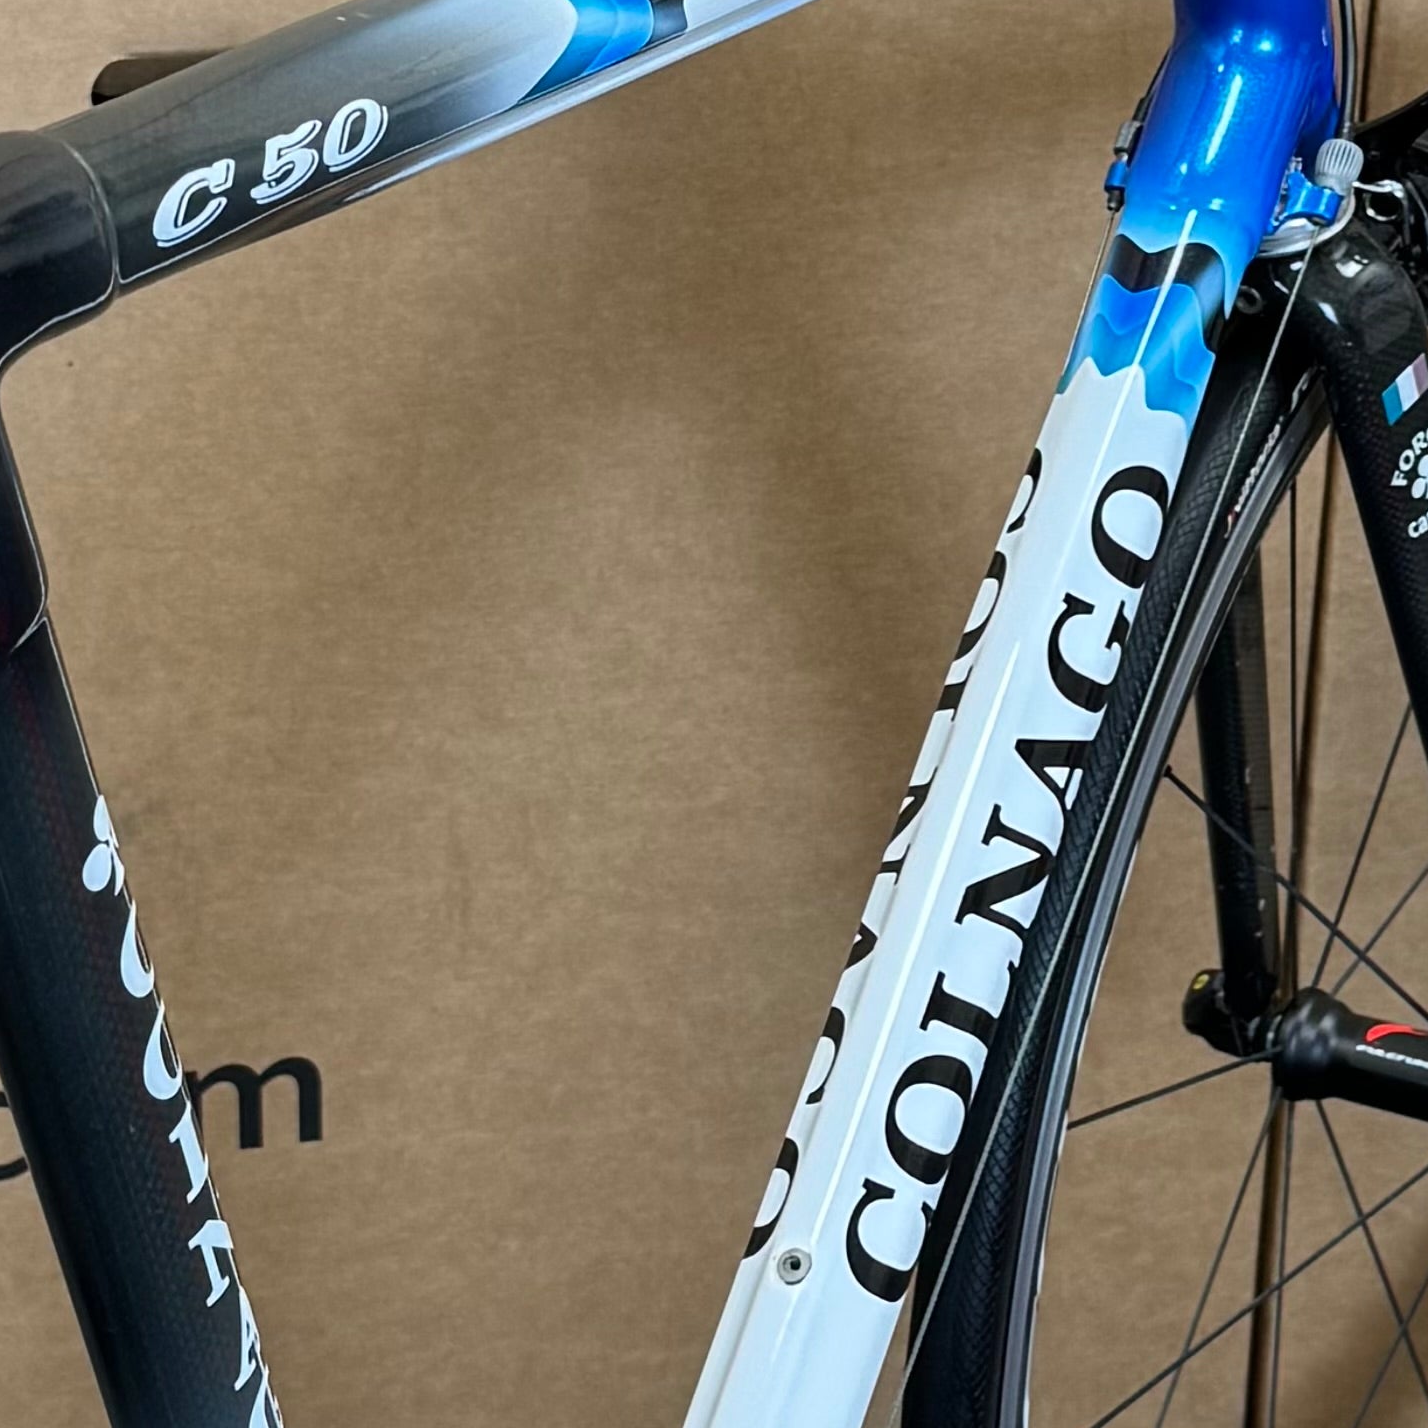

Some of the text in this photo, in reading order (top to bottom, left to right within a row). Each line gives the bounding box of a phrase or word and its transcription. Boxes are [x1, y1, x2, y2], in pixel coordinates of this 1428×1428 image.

[153, 98, 389, 251] C 50
[845, 461, 1174, 1304] COLNAGO
